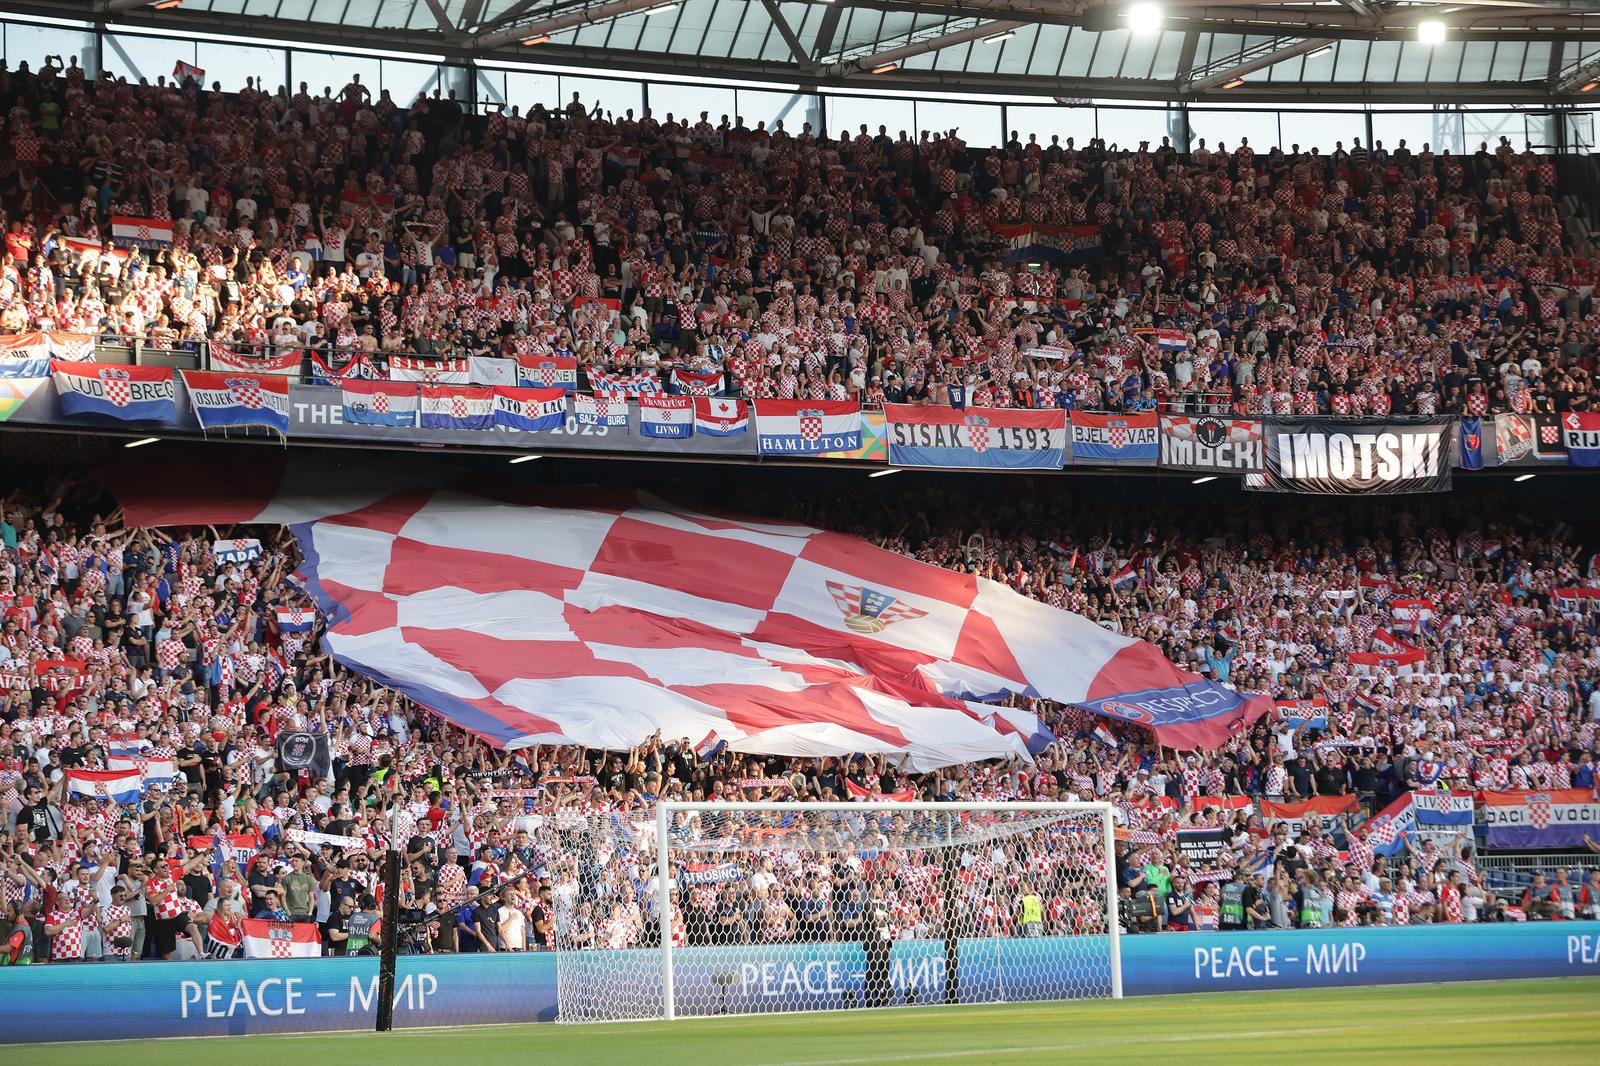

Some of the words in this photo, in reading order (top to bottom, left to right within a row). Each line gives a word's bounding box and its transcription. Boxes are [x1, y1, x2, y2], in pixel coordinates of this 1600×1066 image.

[68, 376, 103, 396] LUD
[131, 381, 174, 400] BREG
[196, 392, 235, 406] OSIJEK
[499, 397, 521, 414] STO
[294, 403, 343, 424] THE
[579, 413, 598, 424] SALZ
[608, 415, 626, 425] BURG
[655, 424, 680, 435] LIVNO
[894, 422, 963, 449] SISAK
[998, 426, 1050, 451] 1593
[1127, 429, 1155, 443] VAR
[762, 436, 858, 451] HAMILTON
[1278, 433, 1441, 481] IMOTSKI
[1136, 688, 1227, 714] RESPECT
[1554, 804, 1600, 821] VOĆI
[1194, 945, 1279, 978] PEACE
[1306, 943, 1366, 975] МИР
[742, 961, 845, 997] PEACE
[181, 977, 306, 1018] PEACE
